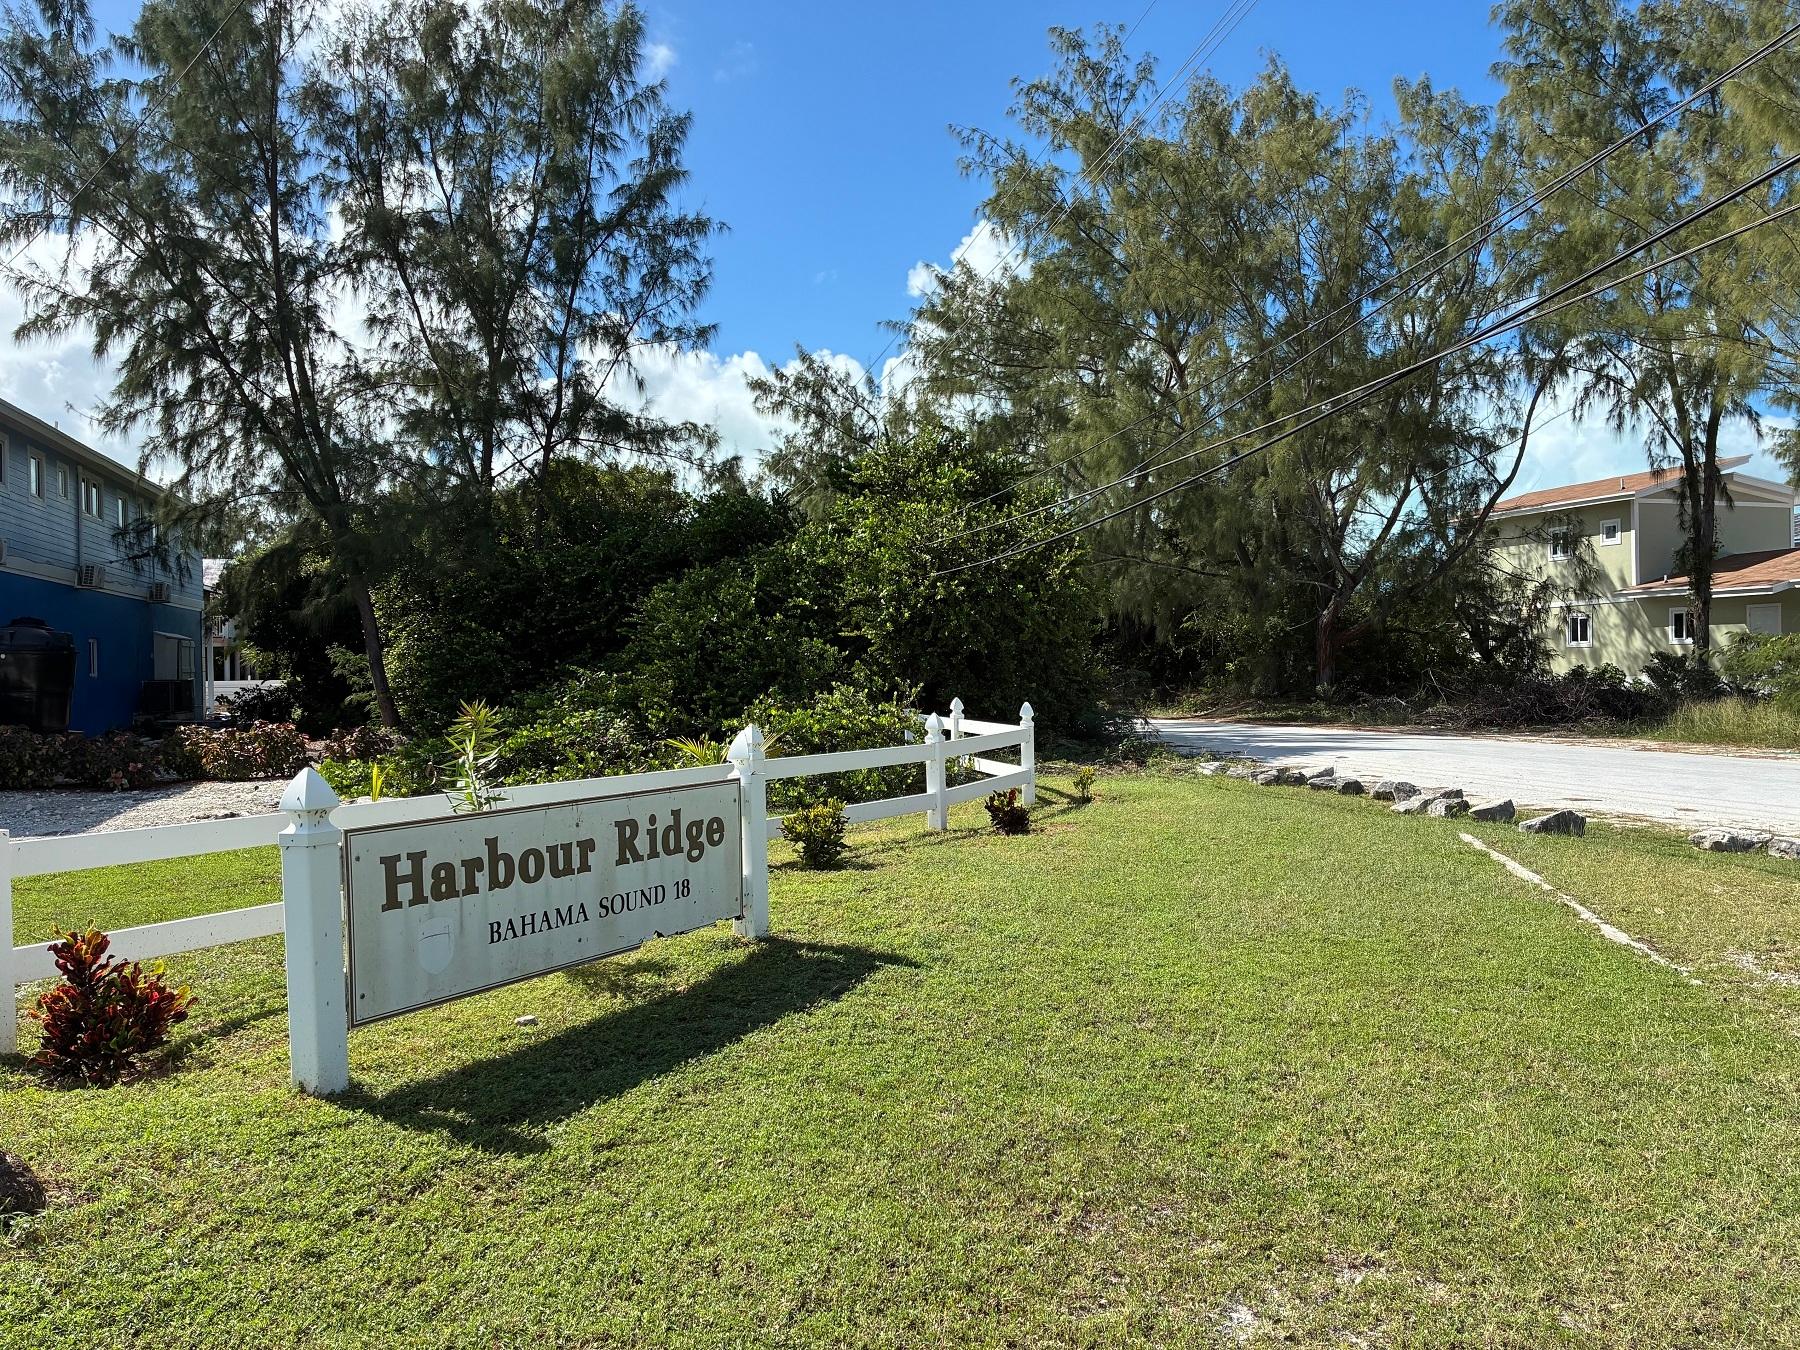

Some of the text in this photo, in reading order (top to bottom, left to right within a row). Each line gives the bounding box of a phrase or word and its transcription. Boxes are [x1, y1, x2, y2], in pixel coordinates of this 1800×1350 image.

[380, 808, 725, 913] Harbour Ridge
[488, 878, 691, 945] BAHAMA SOUND 18
